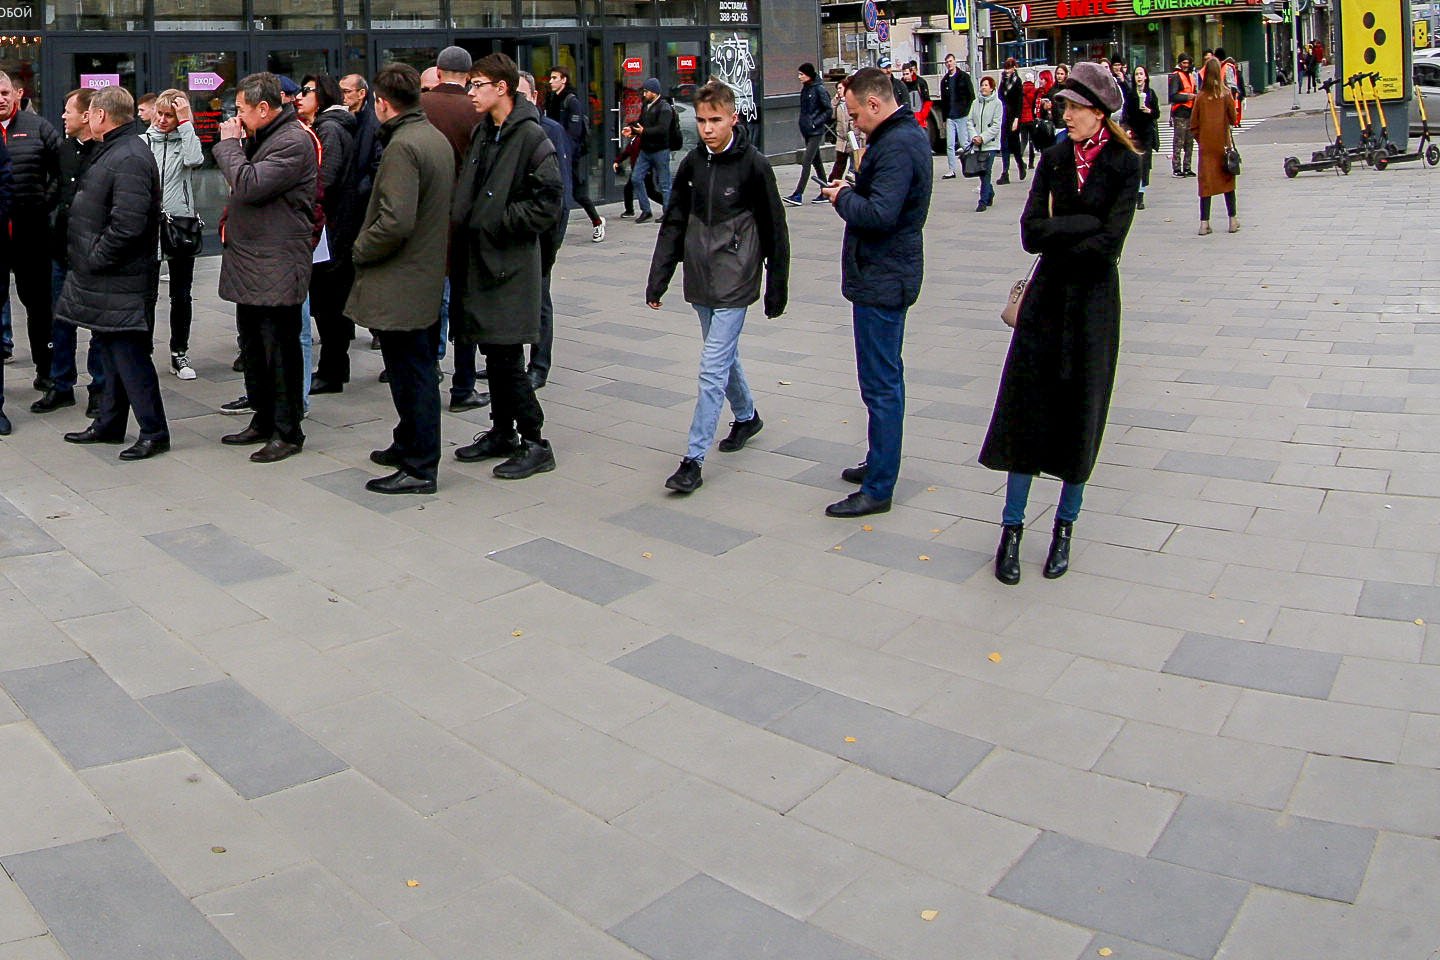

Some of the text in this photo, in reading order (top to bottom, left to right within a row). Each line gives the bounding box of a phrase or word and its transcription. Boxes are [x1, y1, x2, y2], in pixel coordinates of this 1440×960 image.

[719, 1, 748, 10] ДОСТАВКА
[89, 79, 110, 88] ВХОД
[194, 77, 214, 85] ВХОД
